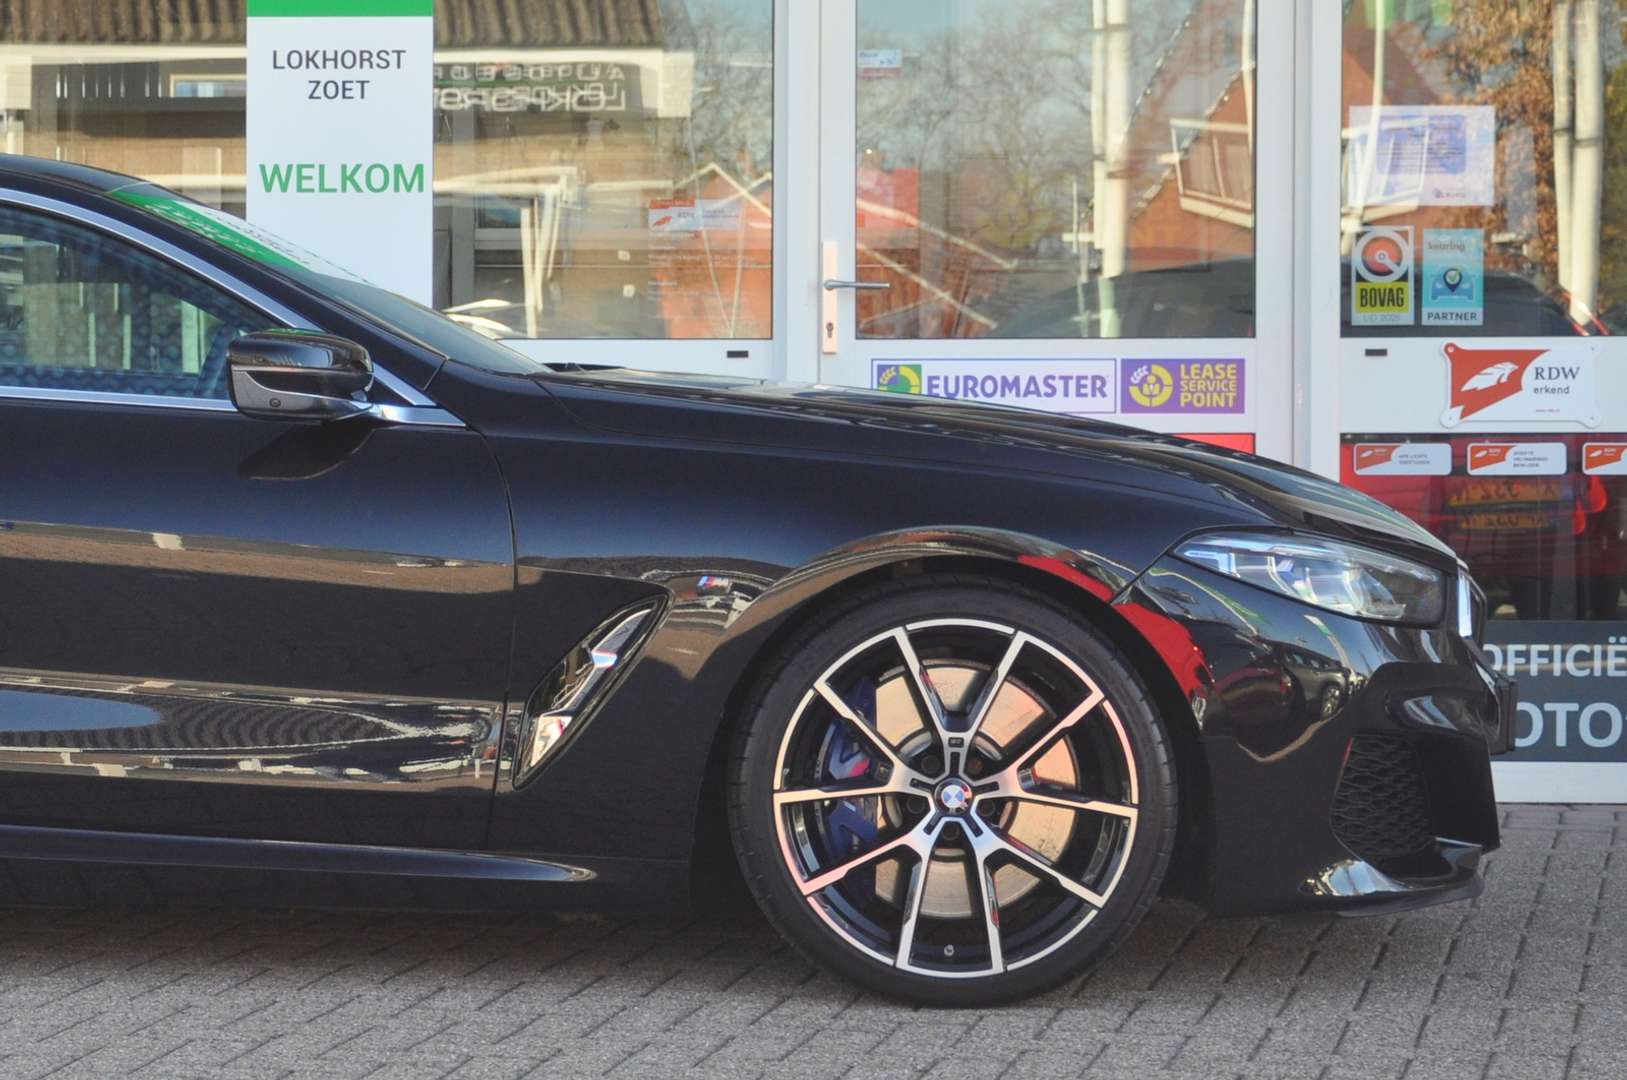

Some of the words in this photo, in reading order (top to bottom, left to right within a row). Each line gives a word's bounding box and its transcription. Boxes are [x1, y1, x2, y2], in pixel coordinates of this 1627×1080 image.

[272, 50, 407, 70] LOKHORST
[308, 81, 370, 100] ZOET
[259, 163, 425, 193] WELKOM
[1360, 287, 1404, 308] BOVAG
[1427, 311, 1477, 321] PARTNER
[1180, 363, 1237, 380] LEASE
[1534, 366, 1580, 381] RDW
[927, 374, 1108, 399] EUROMASTER
[1180, 380, 1237, 392] SERVICE
[1533, 385, 1570, 395] erkend
[1180, 392, 1237, 408] POINT
[1515, 702, 1627, 748] OTO
